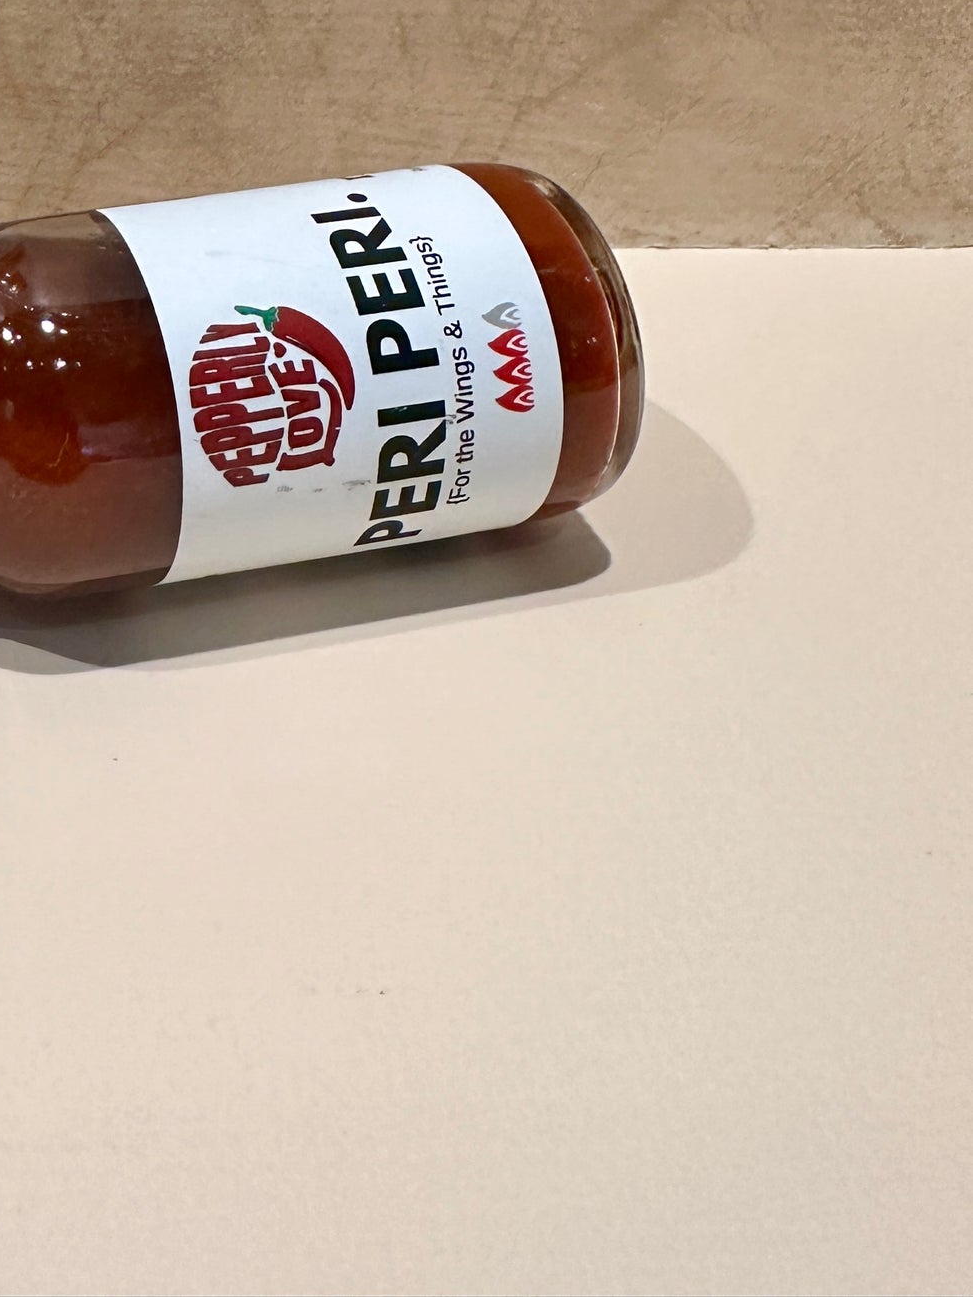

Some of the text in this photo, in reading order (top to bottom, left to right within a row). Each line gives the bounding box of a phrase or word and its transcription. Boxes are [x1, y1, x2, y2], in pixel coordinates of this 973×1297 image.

[443, 319, 463, 339] &
[189, 322, 285, 487] PEPPERLY
[268, 359, 342, 471] LOVE
[453, 346, 475, 424] Wings
[354, 400, 446, 546] PERI
[455, 429, 474, 464] the
